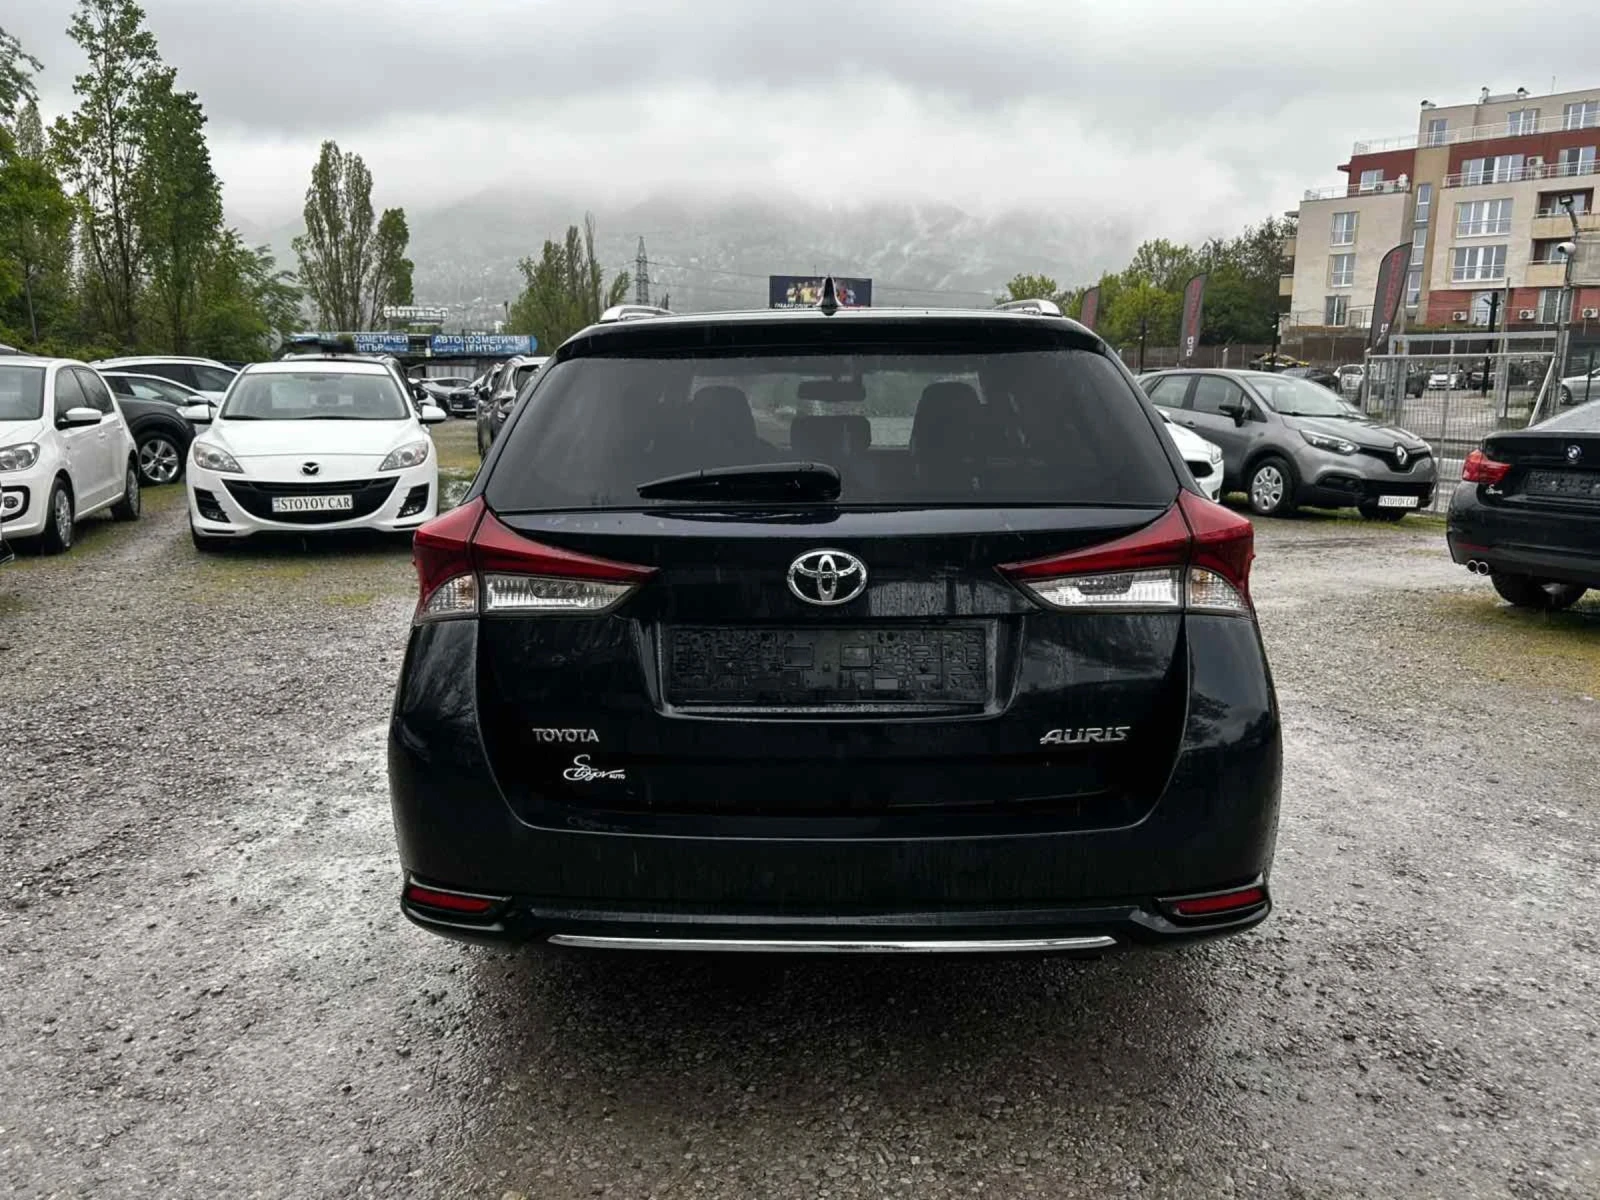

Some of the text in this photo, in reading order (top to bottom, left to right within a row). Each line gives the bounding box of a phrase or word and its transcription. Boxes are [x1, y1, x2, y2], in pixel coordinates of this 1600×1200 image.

[281, 497, 350, 510] STOYOV CAR
[532, 728, 599, 742] TOYOTA
[1040, 726, 1131, 744] AURIS
